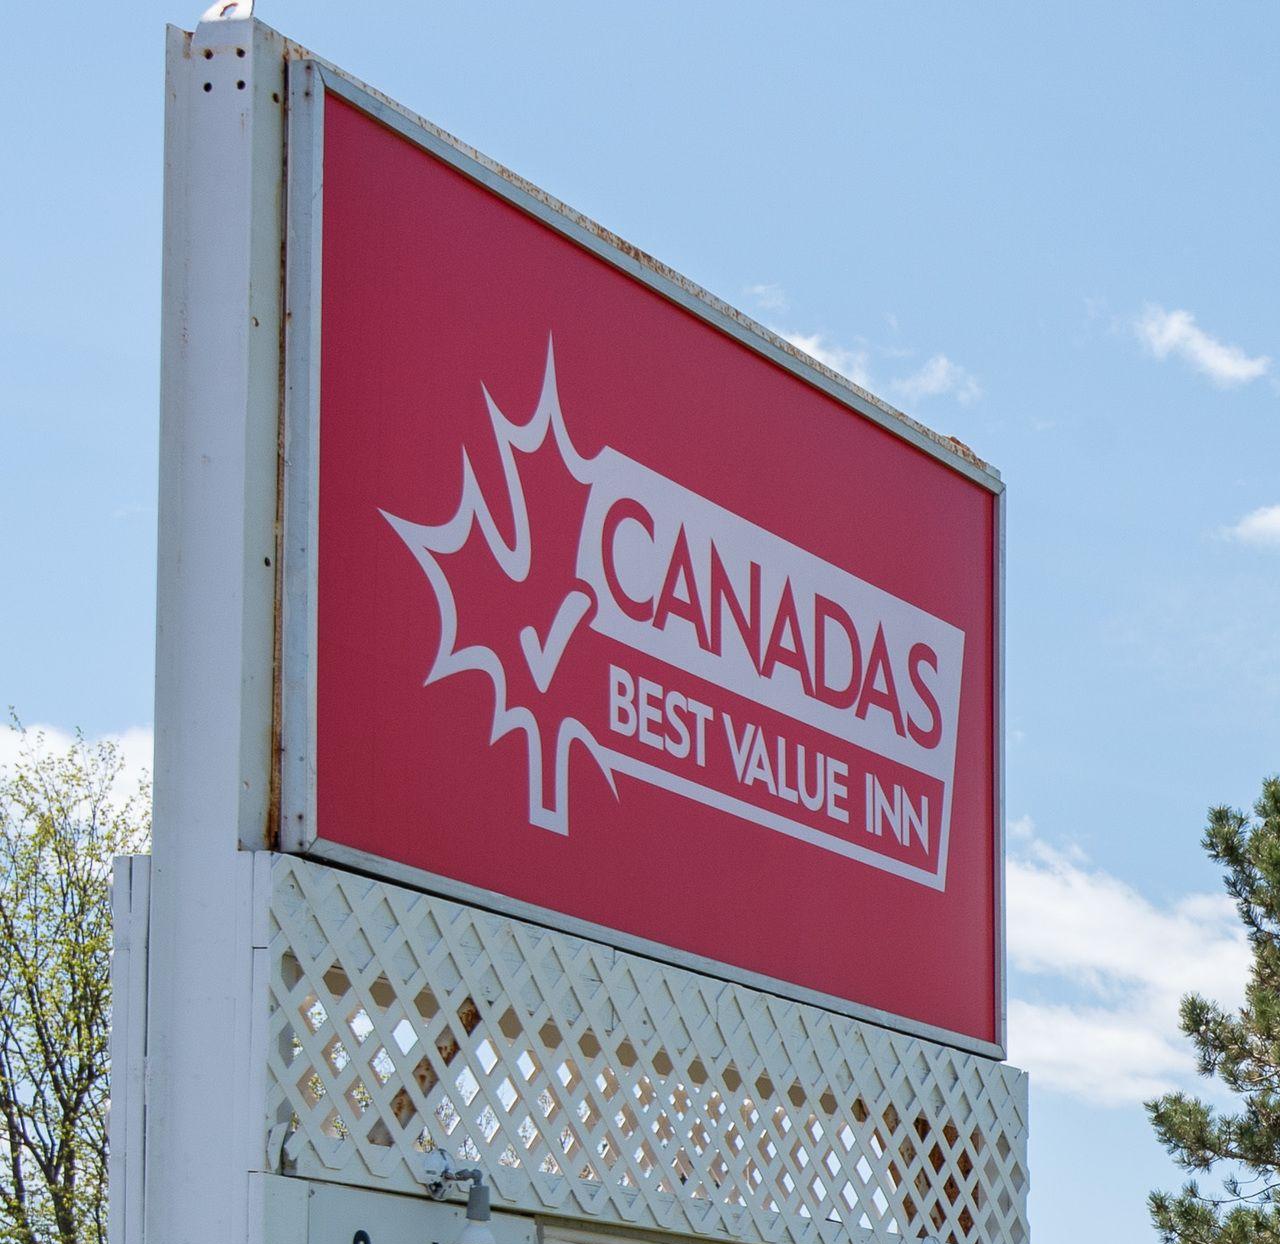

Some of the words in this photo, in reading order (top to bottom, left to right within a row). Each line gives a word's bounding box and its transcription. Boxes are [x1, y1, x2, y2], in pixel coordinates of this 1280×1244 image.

[602, 498, 942, 750] CANADAS
[609, 664, 714, 767] BEST
[722, 712, 850, 824] VALUE
[865, 773, 929, 856] INN
